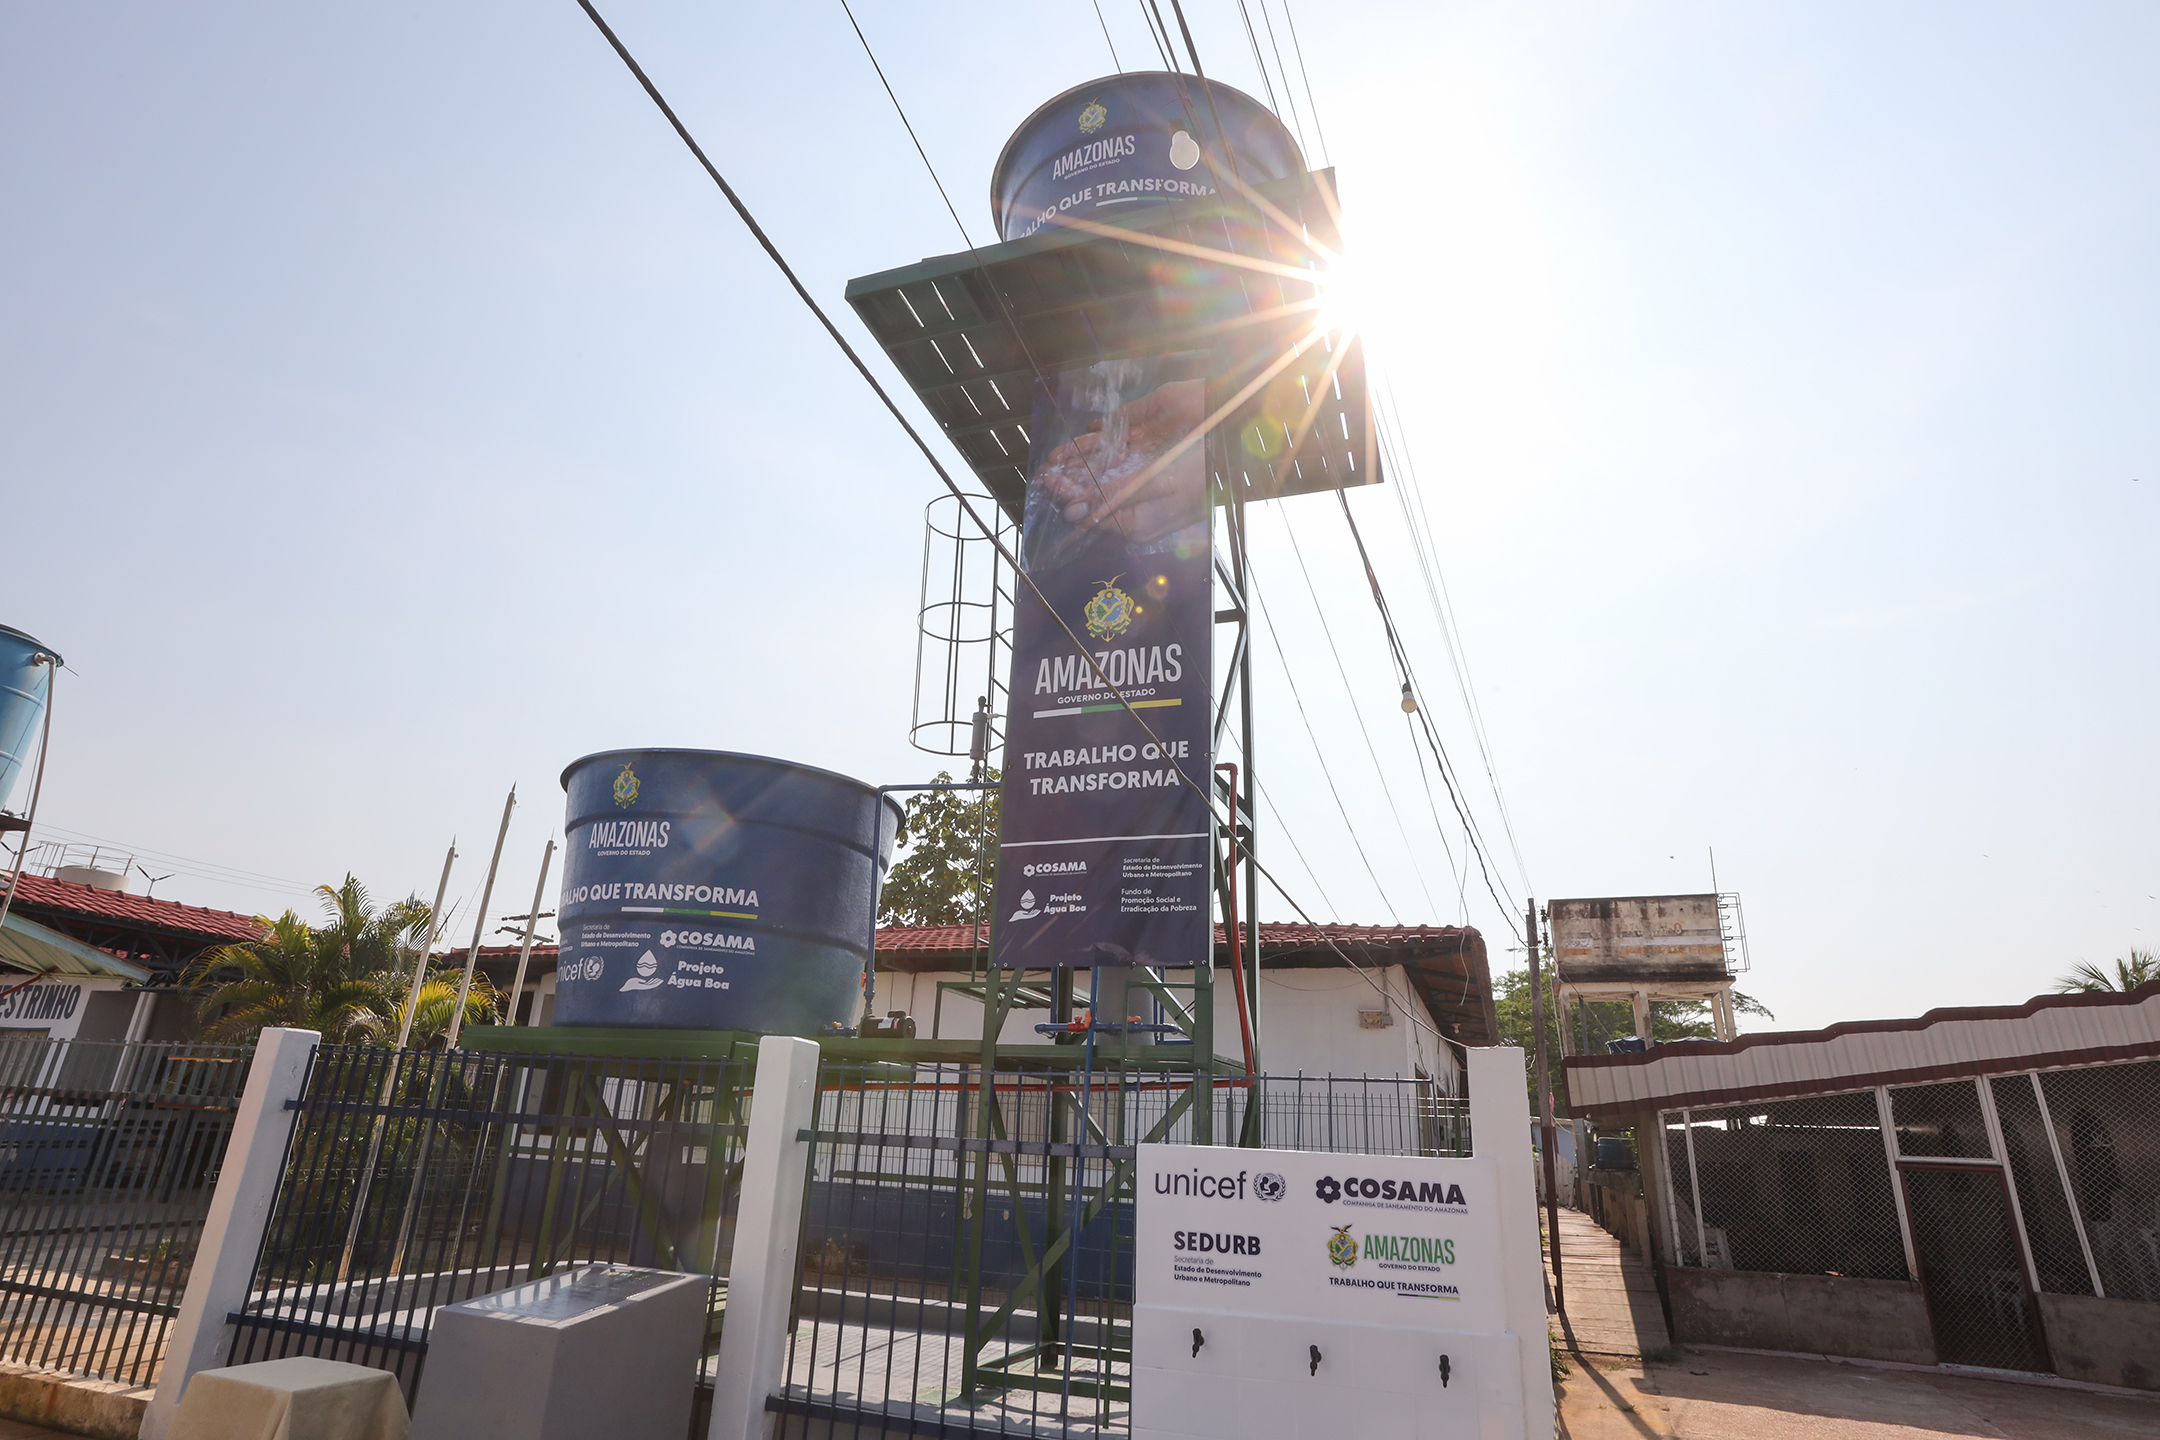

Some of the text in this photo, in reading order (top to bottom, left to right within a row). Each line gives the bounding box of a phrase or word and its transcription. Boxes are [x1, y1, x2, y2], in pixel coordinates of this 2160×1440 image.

[1052, 135, 1135, 181] AMAZONAS
[1063, 166, 1089, 180] GOVERNO
[1098, 158, 1121, 168] ESTADO
[1020, 205, 1057, 238] ALHO
[1059, 187, 1092, 211] QUE
[1034, 643, 1182, 695] AMAZONAS
[1057, 693, 1102, 704] GOVERNO
[1121, 688, 1156, 698] ESTADO
[1023, 740, 1189, 770] TRABALHO QUE
[1030, 768, 1181, 796] TRANSFORMA
[588, 820, 671, 849] AMAZONAS
[1035, 861, 1087, 873] COSAMA
[1150, 871, 1193, 879] Metropolitano
[590, 883, 621, 901] QUE
[624, 882, 760, 908] TRANSFORMA
[1049, 893, 1082, 904] Projeto
[1121, 897, 1155, 905] Promoção
[1043, 902, 1087, 915] Água Boa
[1120, 905, 1159, 914] Erradicação
[1170, 904, 1197, 912] Pobreza
[678, 930, 755, 951] COSAMA
[677, 960, 724, 975] Projeto
[667, 971, 730, 990] Água Boa
[1155, 1168, 1247, 1200] unicef
[1343, 1177, 1467, 1205] COSAMA
[1342, 1200, 1376, 1208] COMPANHIA
[1385, 1203, 1423, 1211] SANEAMENTO
[1434, 1207, 1468, 1215] AMAZONAS
[1174, 1230, 1261, 1256] SEDURB
[1363, 1234, 1456, 1265] AMAZONAS
[1173, 1255, 1214, 1265] Secretaria de
[1378, 1262, 1407, 1270] GOVERNO
[1174, 1264, 1195, 1273] Estado
[1205, 1267, 1262, 1278] Desenvolvimento
[1173, 1274, 1198, 1282] Urbano
[1203, 1276, 1251, 1287] Metropolitano
[1329, 1276, 1459, 1294] TRABALHO QUE TRANSFORMA
